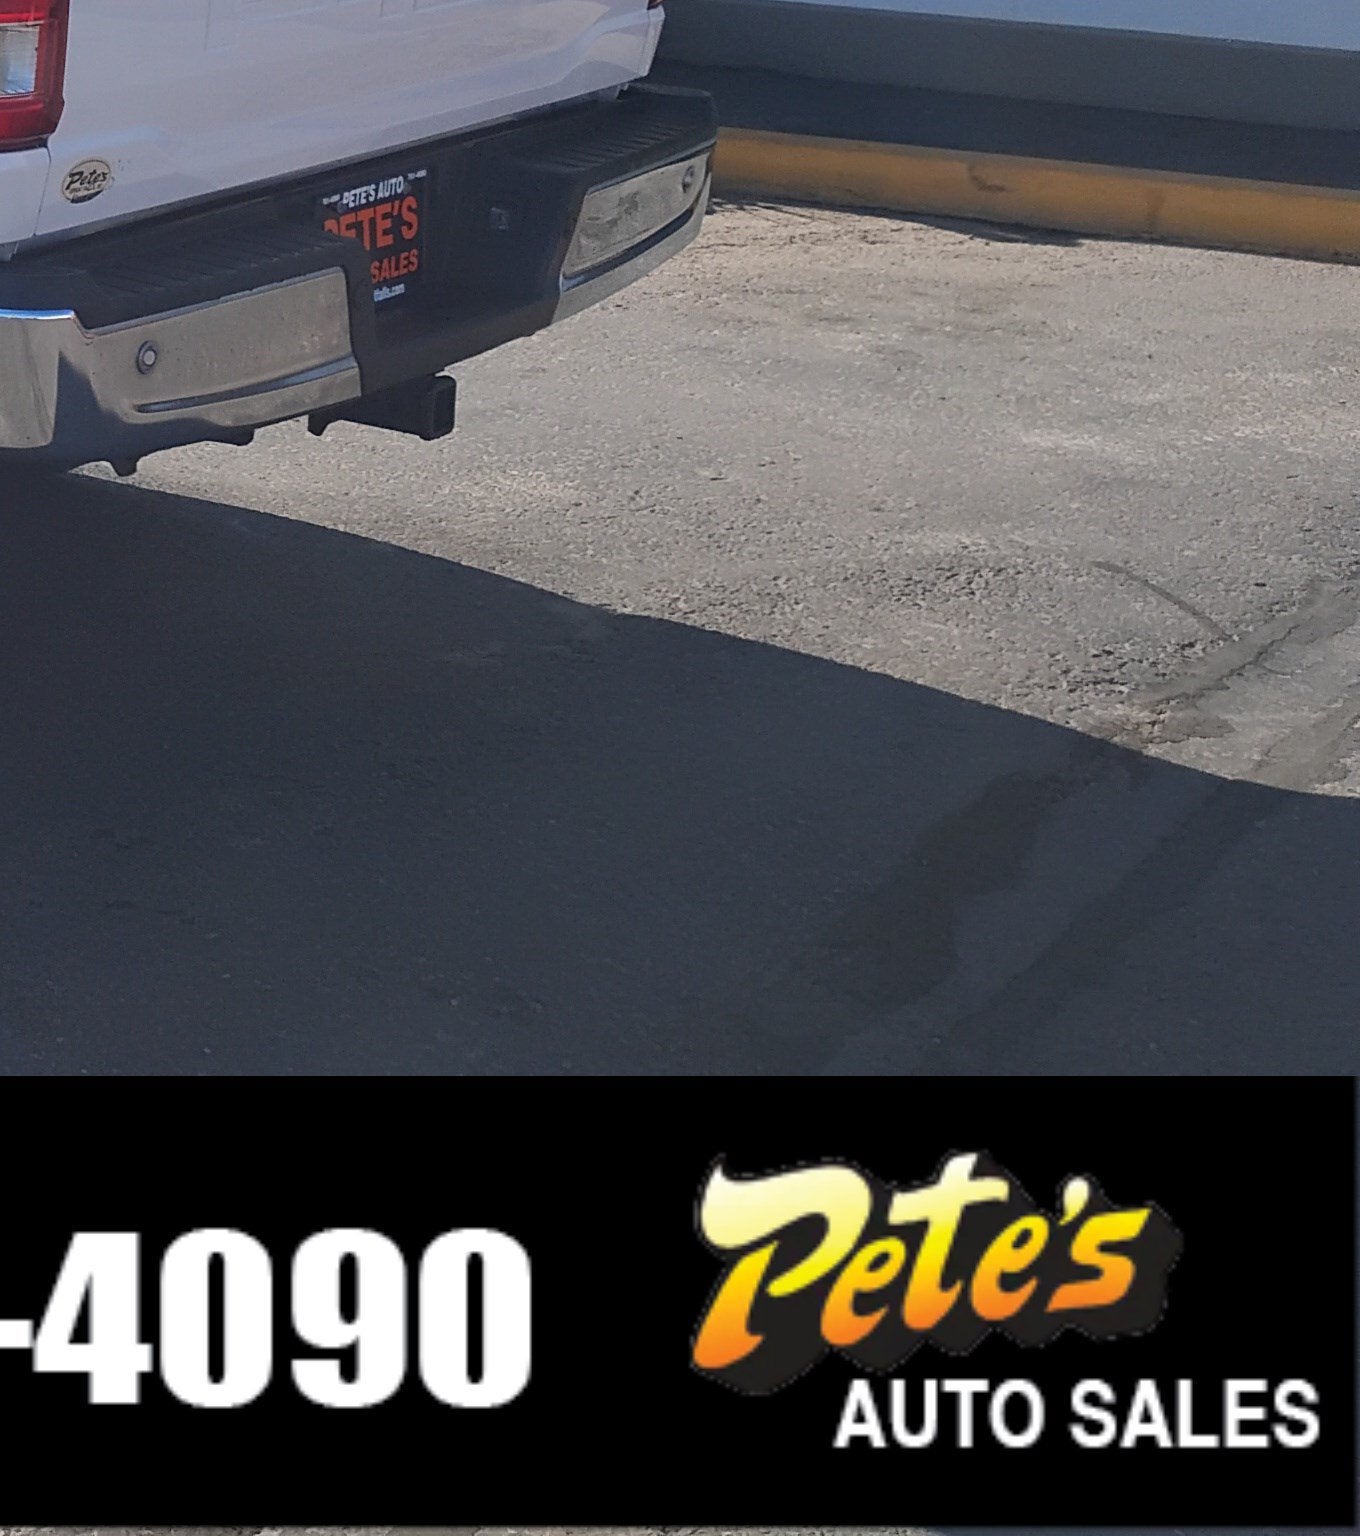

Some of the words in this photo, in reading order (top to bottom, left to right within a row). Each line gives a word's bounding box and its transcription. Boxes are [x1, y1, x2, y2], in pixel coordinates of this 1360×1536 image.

[342, 184, 376, 207] PETE'S
[377, 176, 404, 199] AUTO
[370, 249, 418, 284] SALES
